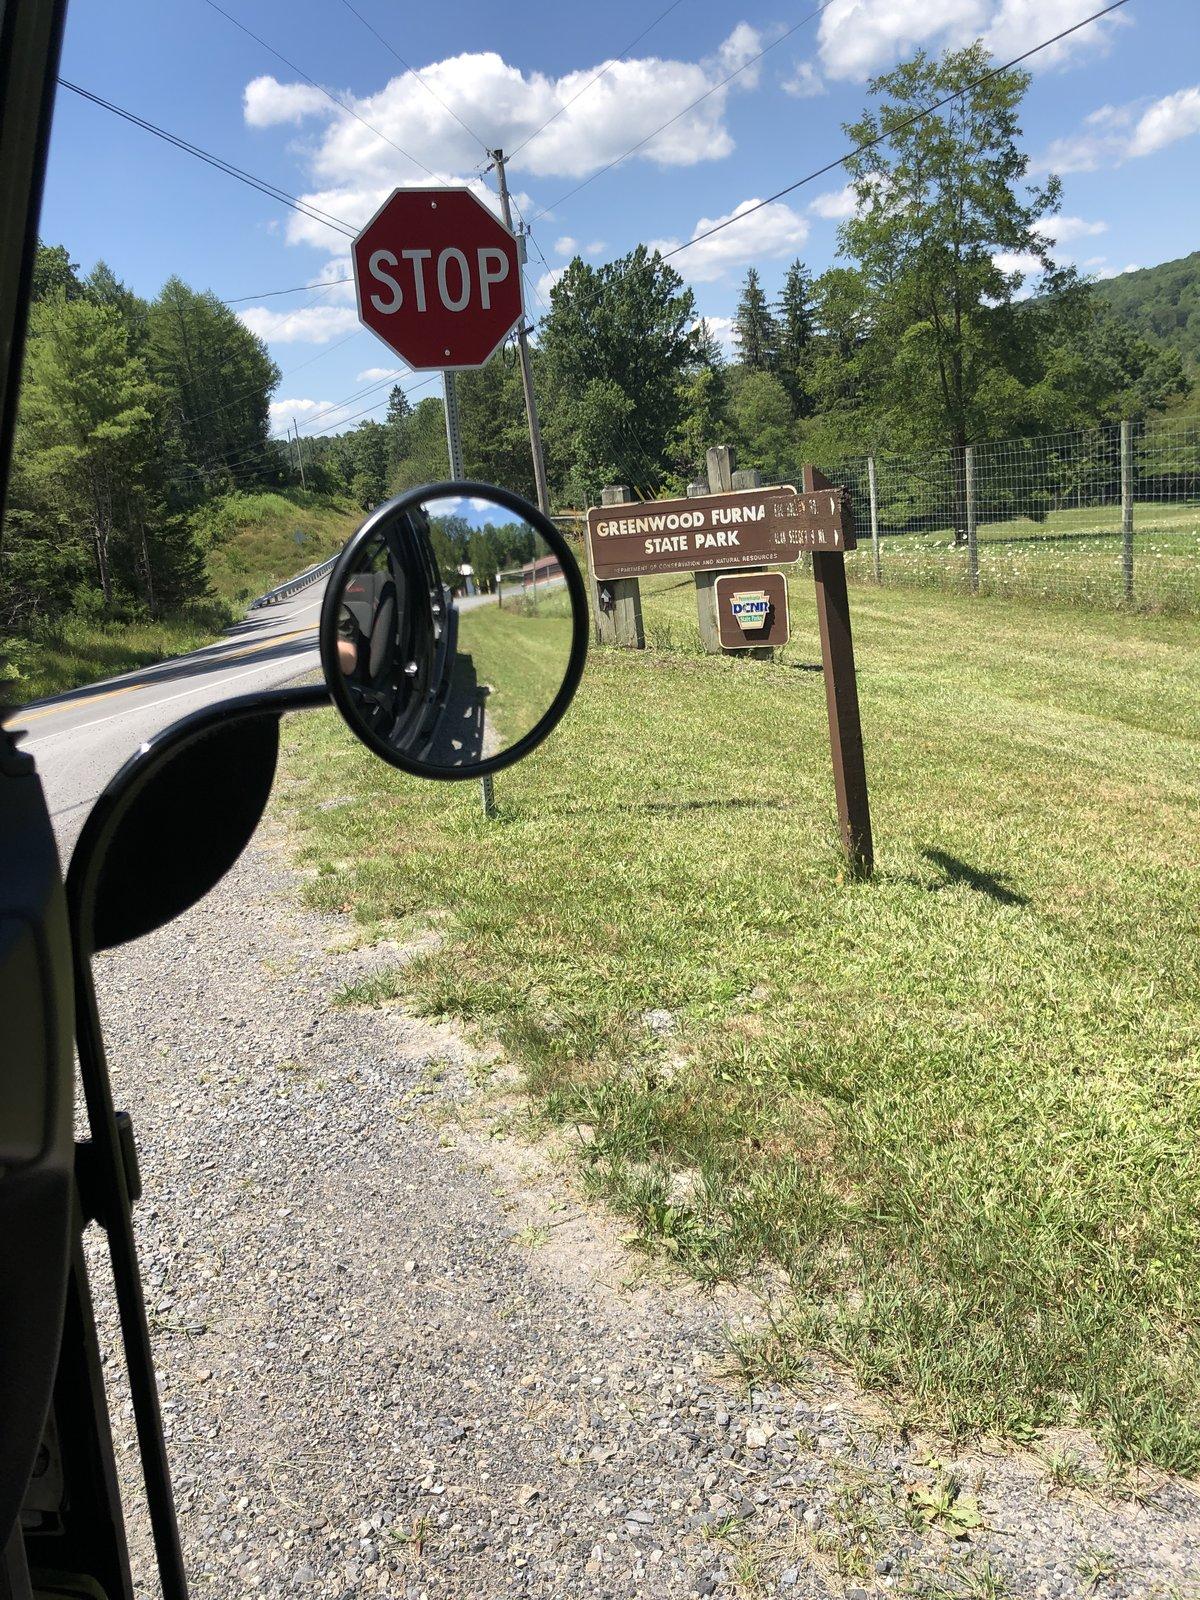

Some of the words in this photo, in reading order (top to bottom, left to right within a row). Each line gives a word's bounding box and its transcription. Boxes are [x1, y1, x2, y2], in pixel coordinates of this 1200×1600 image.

[368, 247, 510, 315] STOP
[596, 511, 705, 537] GREENWOOD
[644, 535, 689, 555] STATE
[694, 530, 740, 549] PARK
[658, 560, 700, 570] CONSERVATION
[715, 556, 740, 564] NATURAL
[742, 552, 778, 563] RESOURCES
